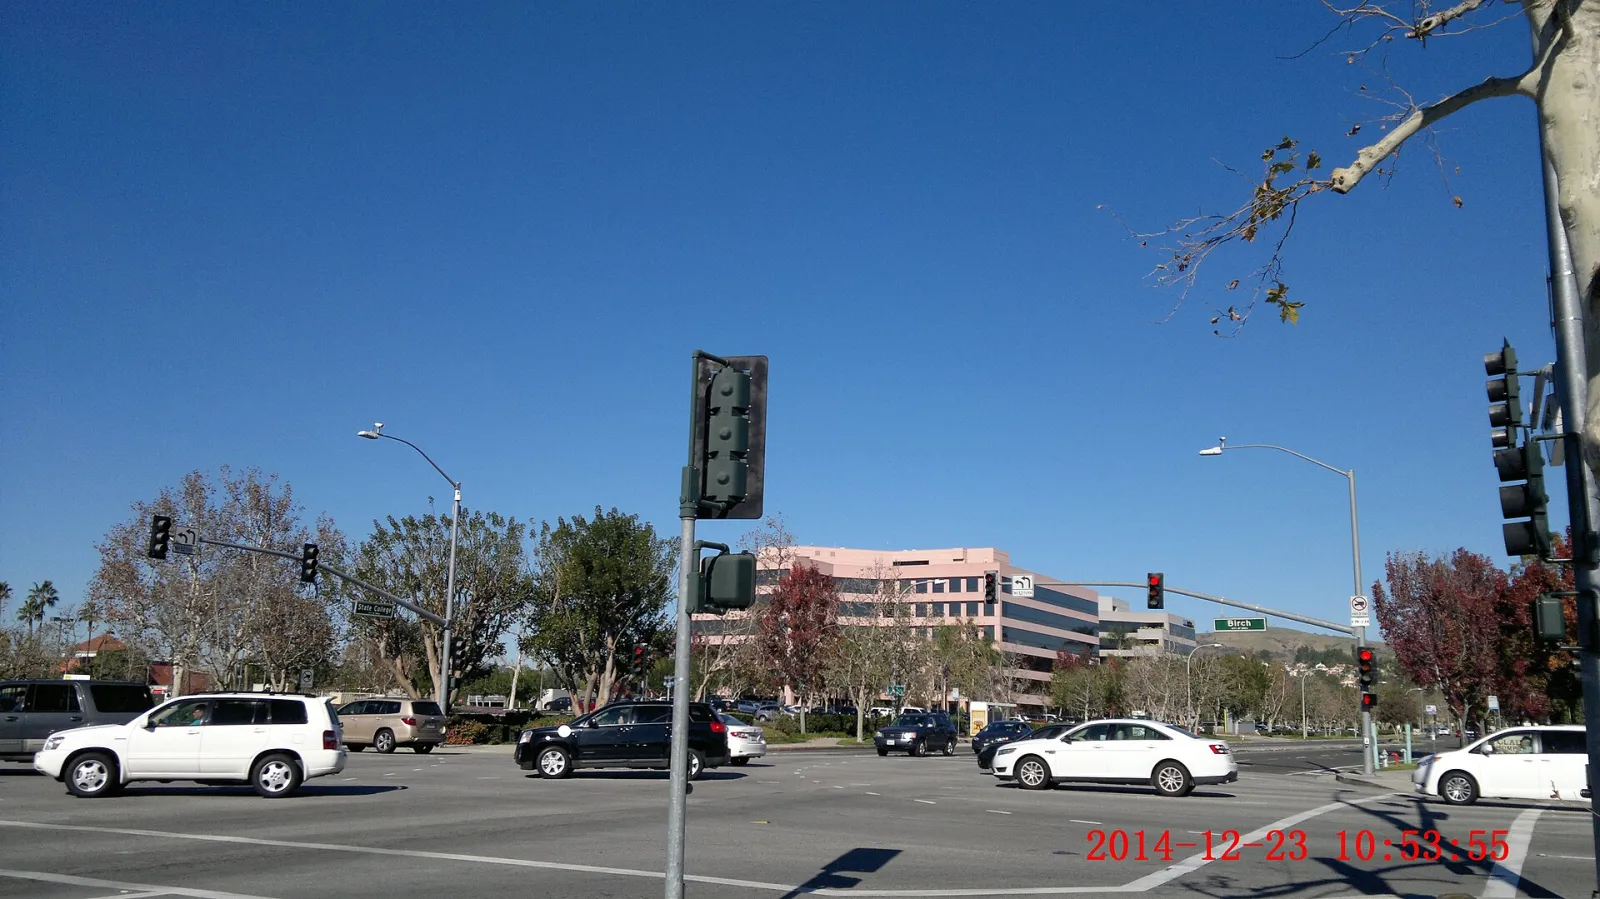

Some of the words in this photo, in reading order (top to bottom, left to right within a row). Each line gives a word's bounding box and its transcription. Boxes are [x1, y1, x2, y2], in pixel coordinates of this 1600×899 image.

[357, 603, 372, 611] State
[373, 605, 392, 615] College
[1227, 619, 1251, 627] Birch
